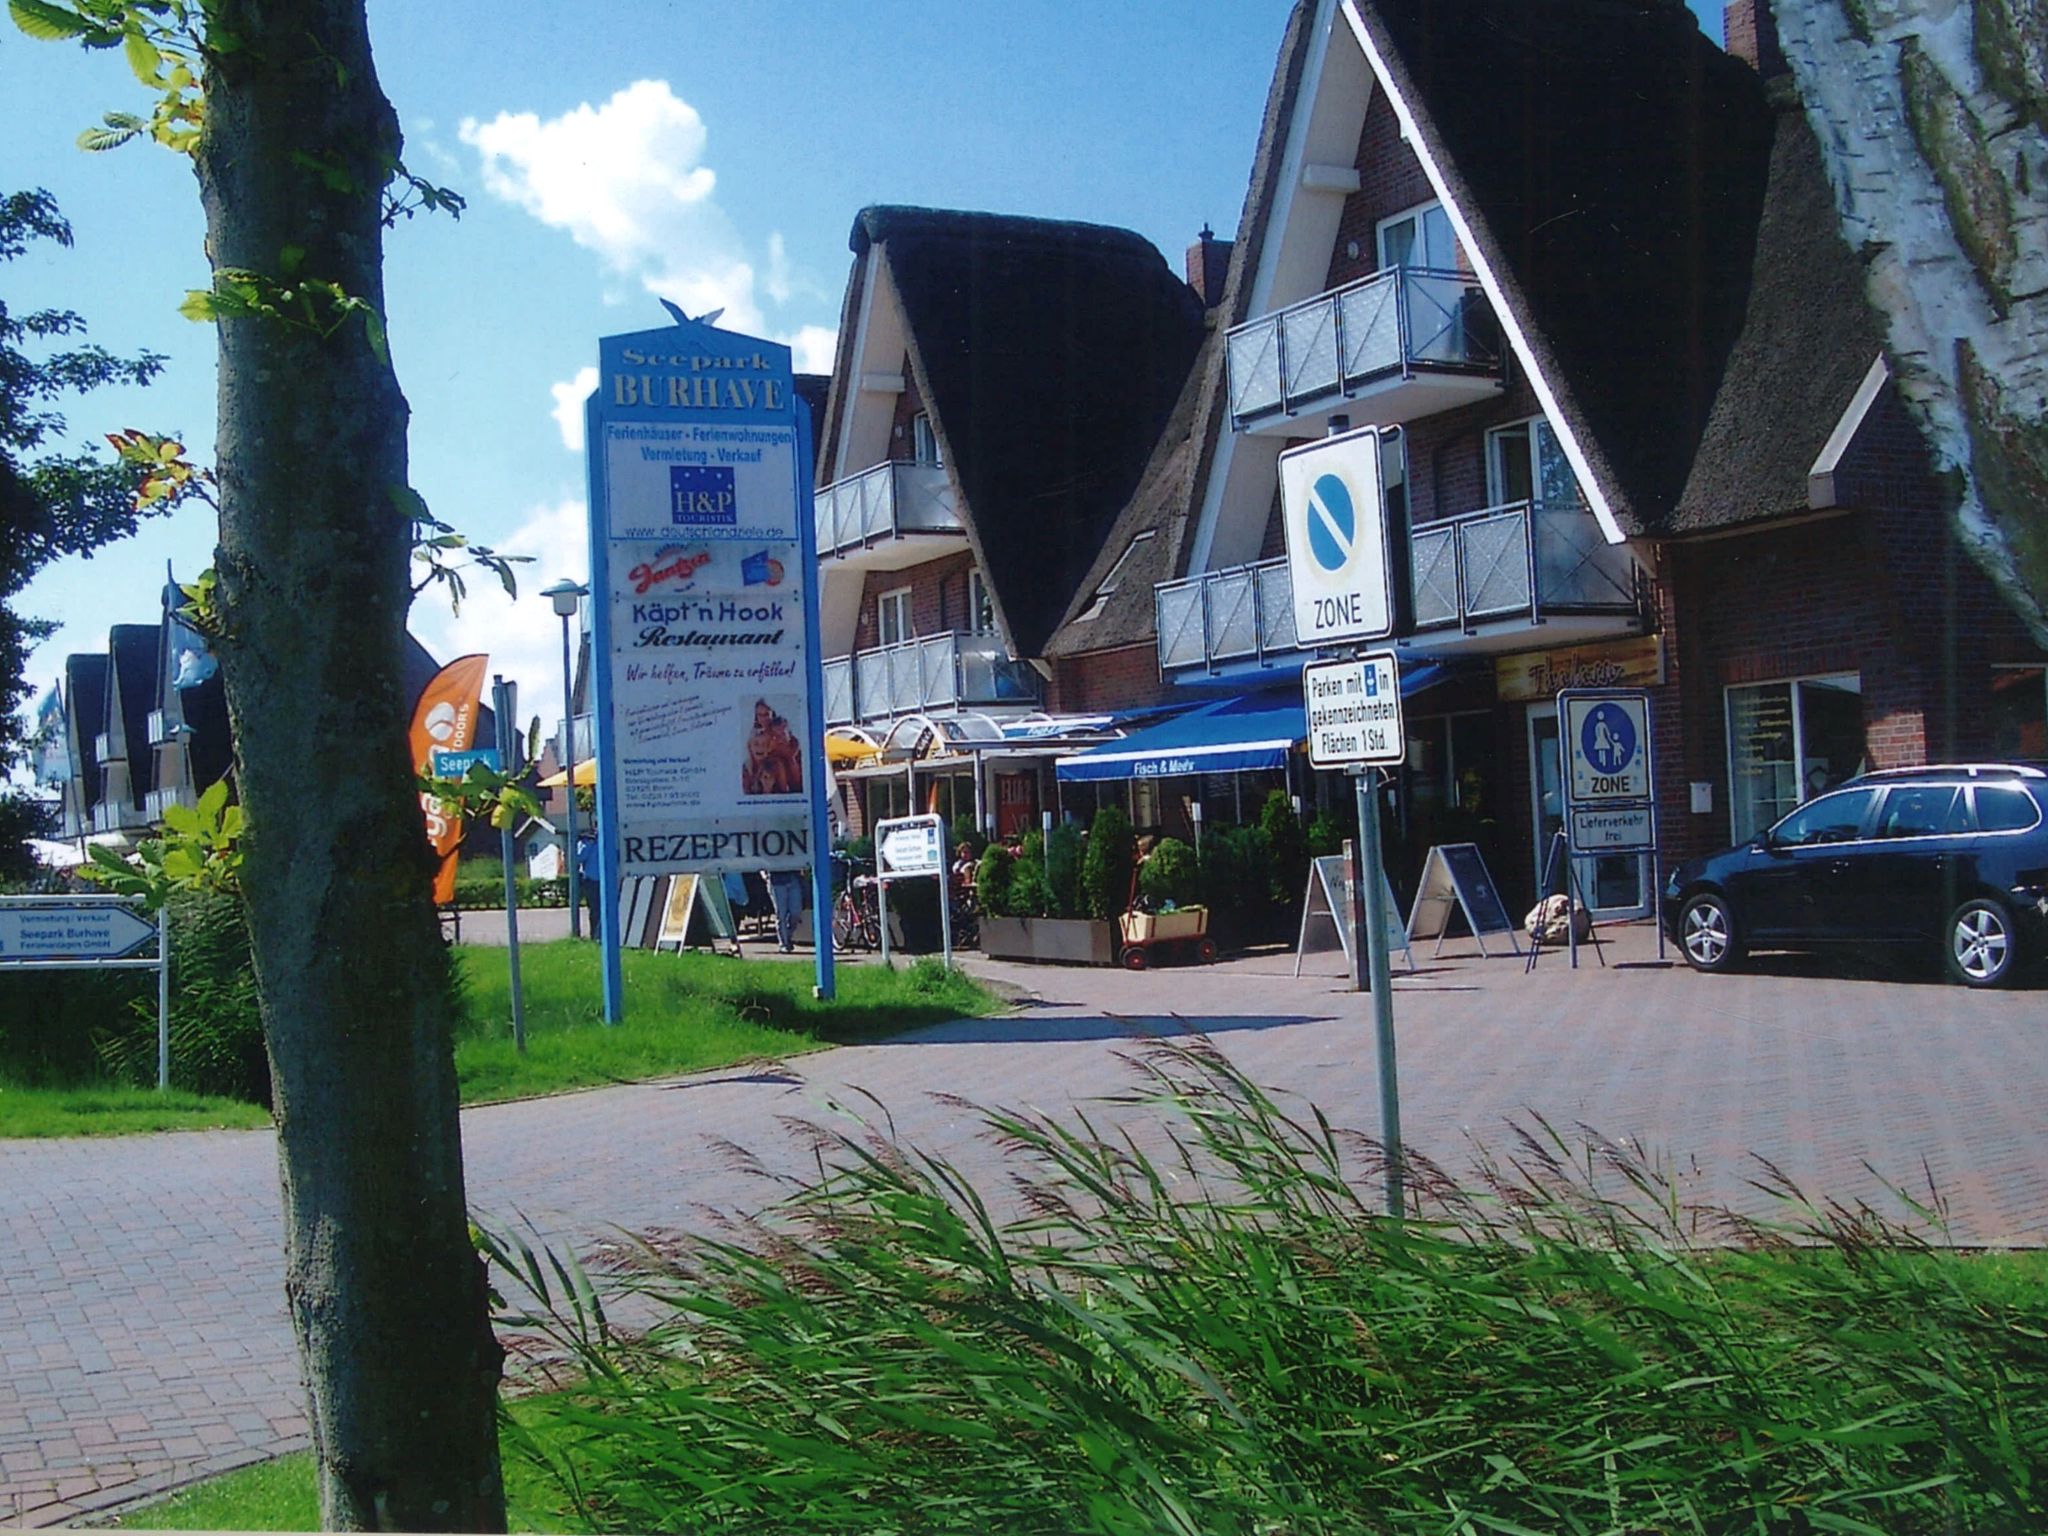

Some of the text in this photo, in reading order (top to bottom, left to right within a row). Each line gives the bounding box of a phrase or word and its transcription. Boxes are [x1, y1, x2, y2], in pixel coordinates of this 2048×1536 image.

[623, 349, 772, 372] Seepark
[613, 373, 785, 410] BURHAVE
[607, 425, 792, 446] Ferienhäuser Ferienwohnungen
[640, 446, 762, 465] Vermietung Verkauf
[675, 490, 733, 514] H&P
[718, 601, 784, 623] Hook
[1314, 592, 1363, 630] ZONE
[632, 626, 785, 649] Restaurant
[626, 663, 648, 682] Wir
[650, 662, 689, 686] helfen,
[693, 660, 732, 680] Träume
[746, 659, 797, 684] erfüllen!
[1311, 667, 1390, 698] Parken mit in
[1311, 698, 1396, 734] gekennzeichneten
[1321, 731, 1358, 756] Flächen
[1368, 727, 1389, 752] Std.
[1133, 761, 1158, 776] Fisch
[1159, 759, 1168, 774] &
[1591, 775, 1631, 794] ZONE
[1579, 814, 1644, 829] Lieferverkehr
[623, 828, 809, 864] REZEPTION
[1604, 831, 1622, 841] frei
[76, 913, 111, 923] Verkauf
[19, 928, 110, 940] Seepark Burhave
